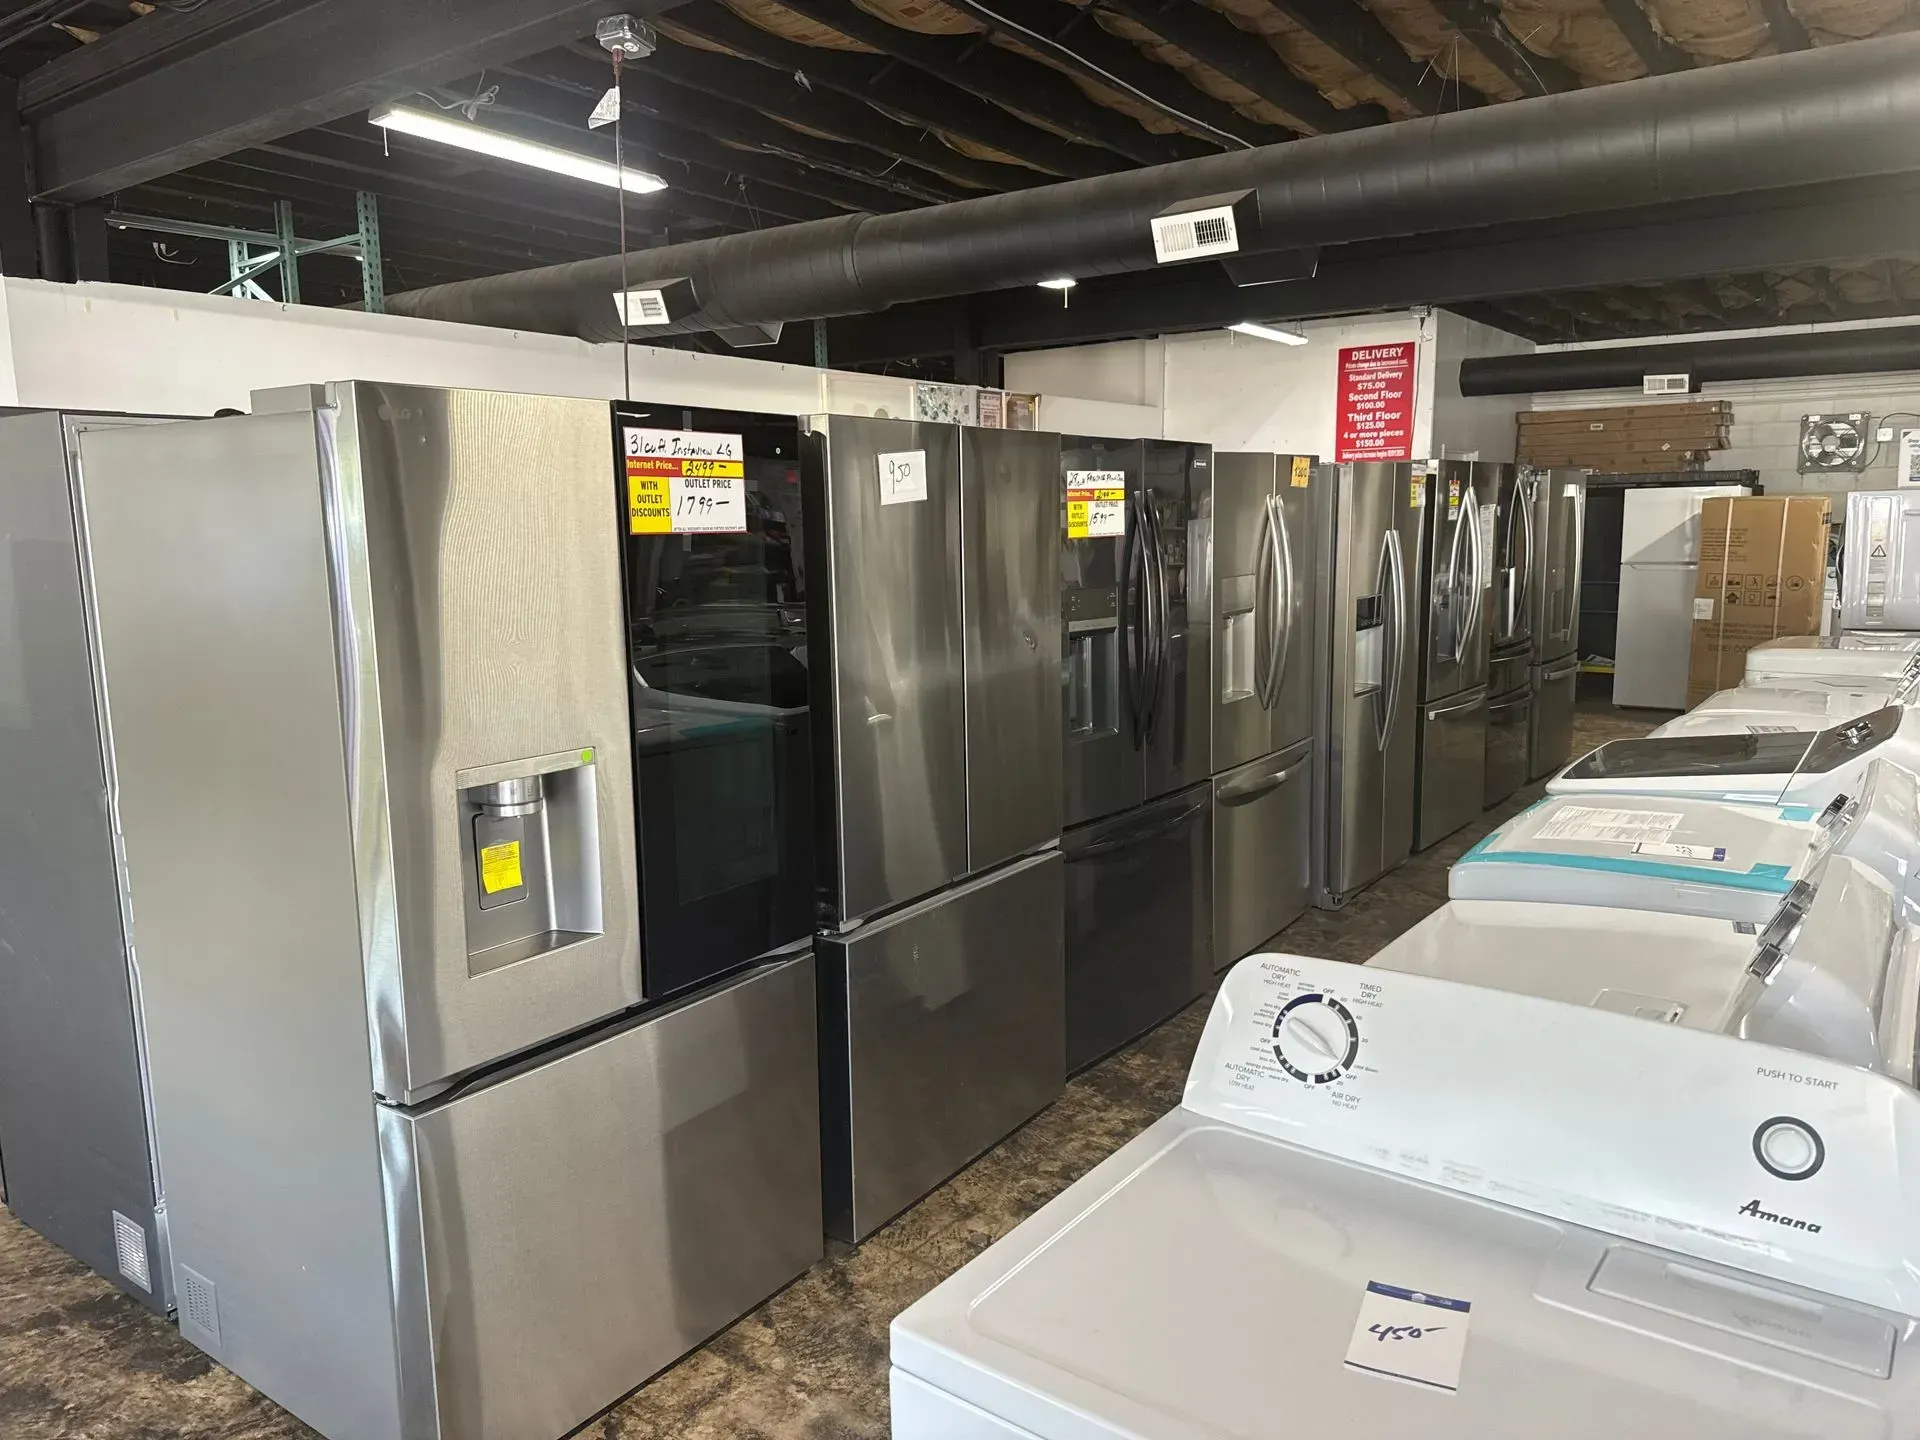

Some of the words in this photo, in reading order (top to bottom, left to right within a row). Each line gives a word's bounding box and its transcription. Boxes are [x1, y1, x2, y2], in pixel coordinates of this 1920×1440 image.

[1352, 347, 1403, 360] DELIVERY
[1349, 371, 1376, 382] Standard
[1377, 371, 1402, 380] Delivery
[1357, 382, 1386, 390] $75.00
[1349, 392, 1378, 402] Second
[1381, 391, 1402, 400] Floor
[1356, 401, 1385, 410] $100.00
[1347, 412, 1373, 422] Third
[1376, 412, 1402, 420] Floor
[1356, 421, 1385, 430] $125.00
[1380, 430, 1404, 438] pieces
[1356, 439, 1384, 448] $150.00
[716, 443, 732, 458] LG
[627, 459, 654, 469] Internet
[889, 460, 910, 494] 950
[641, 481, 658, 490] WITH
[685, 479, 710, 488] OUTLET
[713, 480, 731, 489] PRICE
[637, 494, 663, 504] OUTLET
[632, 508, 670, 517] DISCOUNTS
[1260, 963, 1301, 976] AUTOMATIC
[1272, 973, 1286, 981] DRY
[1360, 983, 1382, 993] TIMED
[1361, 991, 1377, 1000] DRY
[1368, 1000, 1383, 1008] HEAT
[1225, 1062, 1265, 1078] AUTOMATIC
[1236, 1073, 1251, 1082] DRY
[1345, 1073, 1358, 1081] OFF
[1757, 1067, 1786, 1080] PUSH
[1788, 1073, 1803, 1083] TO
[1805, 1077, 1839, 1091] START
[1331, 1091, 1344, 1100] AIR
[1345, 1094, 1361, 1104] DRY
[1343, 1102, 1358, 1111] HEAT
[1738, 1199, 1822, 1233] Amana
